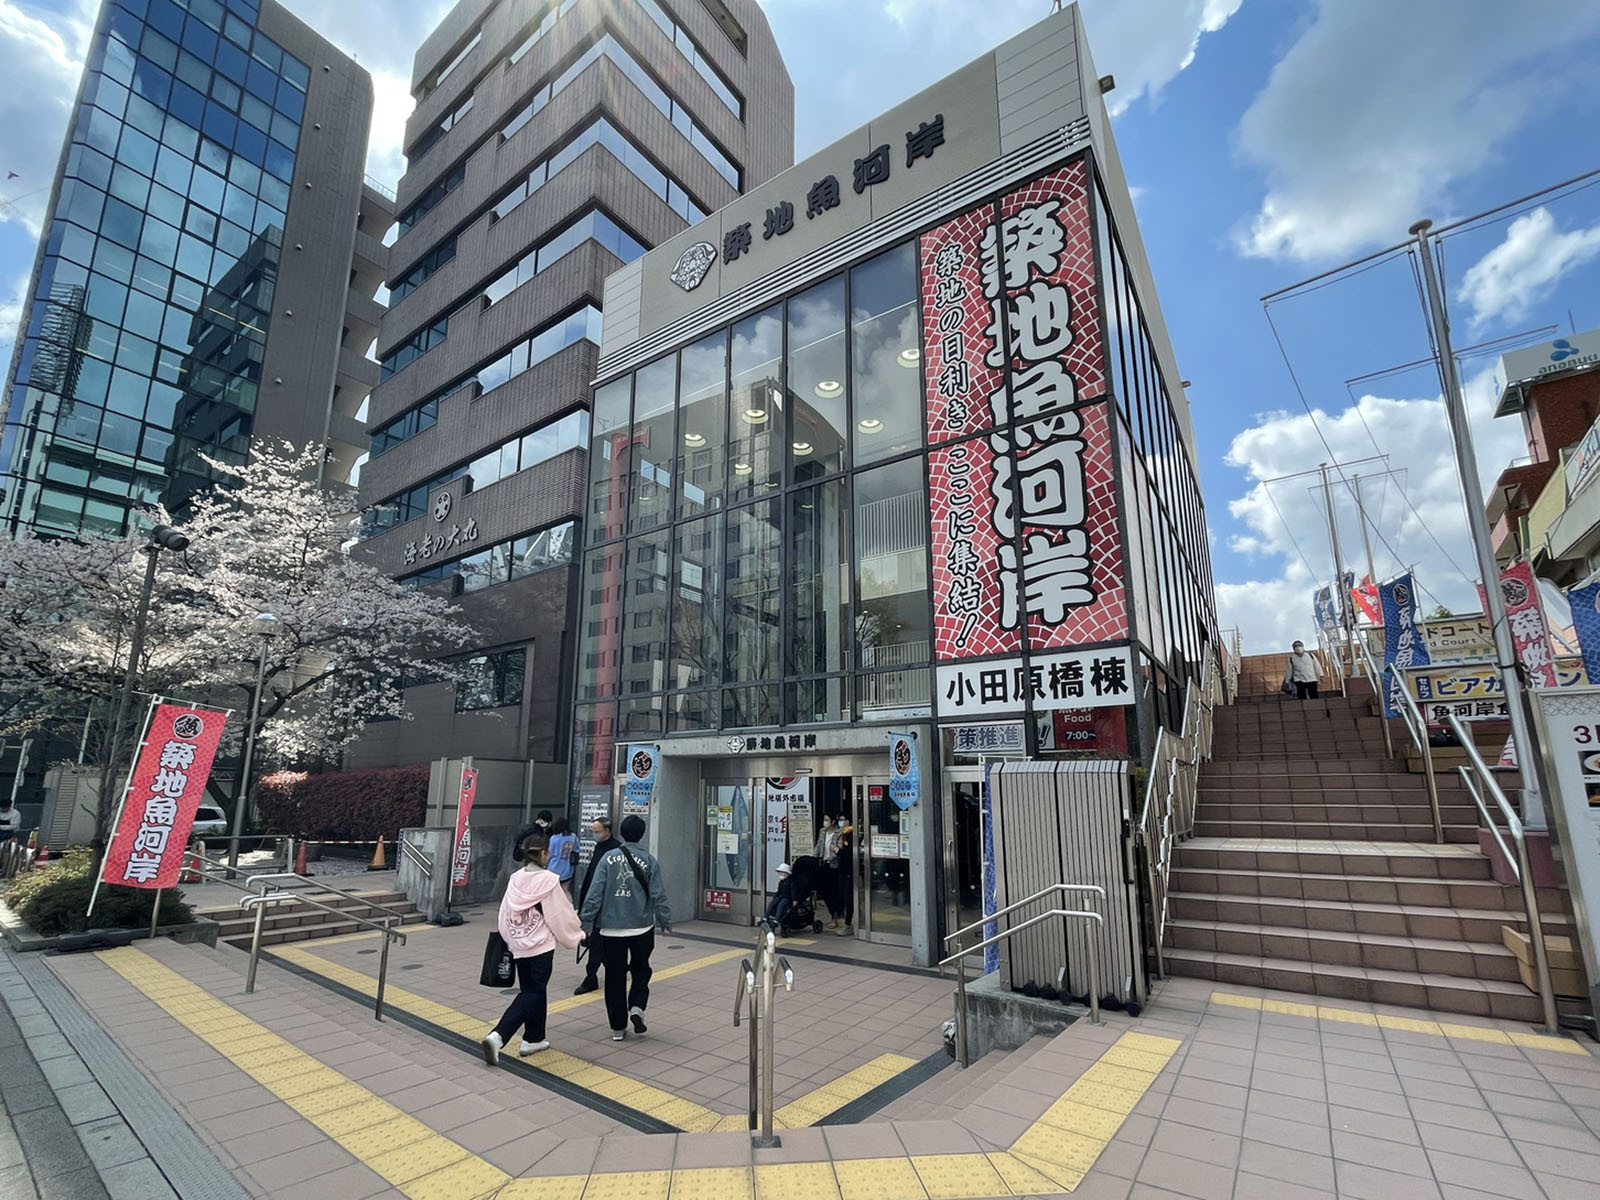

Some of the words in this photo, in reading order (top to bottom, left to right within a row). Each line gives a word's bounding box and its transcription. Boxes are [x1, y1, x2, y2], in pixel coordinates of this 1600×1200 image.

[722, 113, 946, 266] 築地魚河岸
[980, 197, 1097, 631] 築地魚河岸
[946, 657, 1129, 707] 小田原橋棟
[746, 734, 816, 751] 築地魚河岸
[953, 727, 1021, 750] 策推進
[1064, 714, 1092, 723] Food
[122, 740, 197, 882] 築地魚河岸
